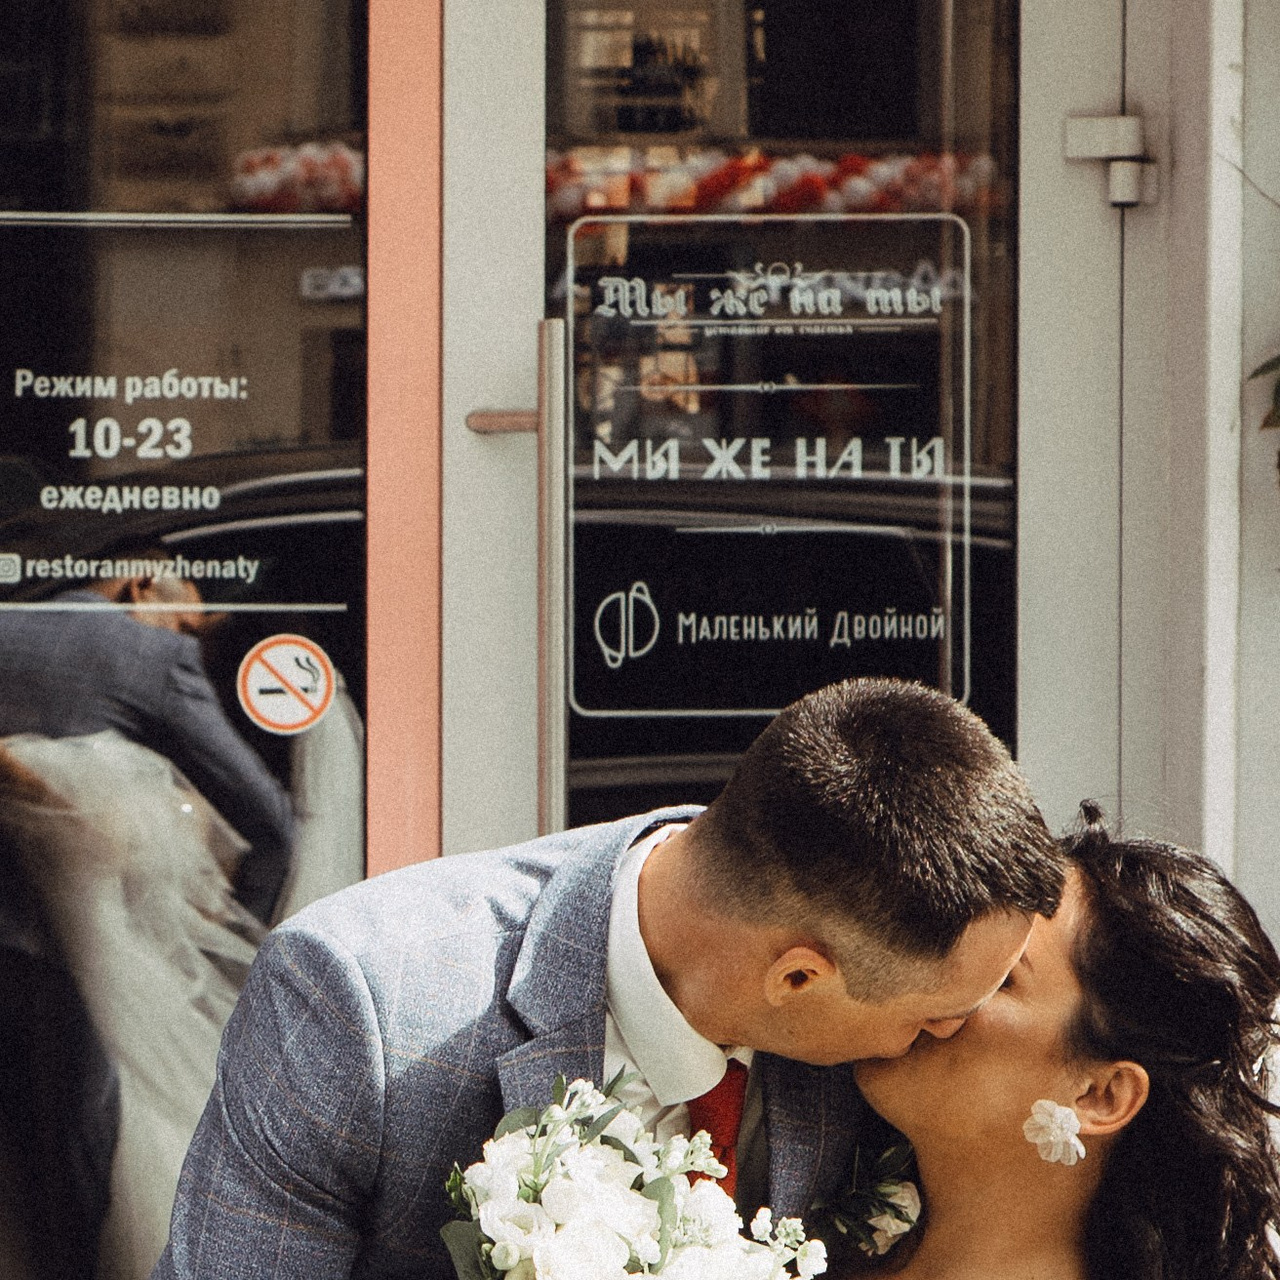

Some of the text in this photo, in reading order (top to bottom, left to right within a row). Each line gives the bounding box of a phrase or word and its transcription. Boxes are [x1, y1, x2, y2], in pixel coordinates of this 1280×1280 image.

[15, 369, 248, 405] Режим работы:
[68, 417, 193, 460] 10-23
[593, 436, 945, 480] МЫ ЖЕ НА ТЫ
[39, 485, 221, 514] ежедневно
[25, 554, 260, 584] restoranmyzhenaty
